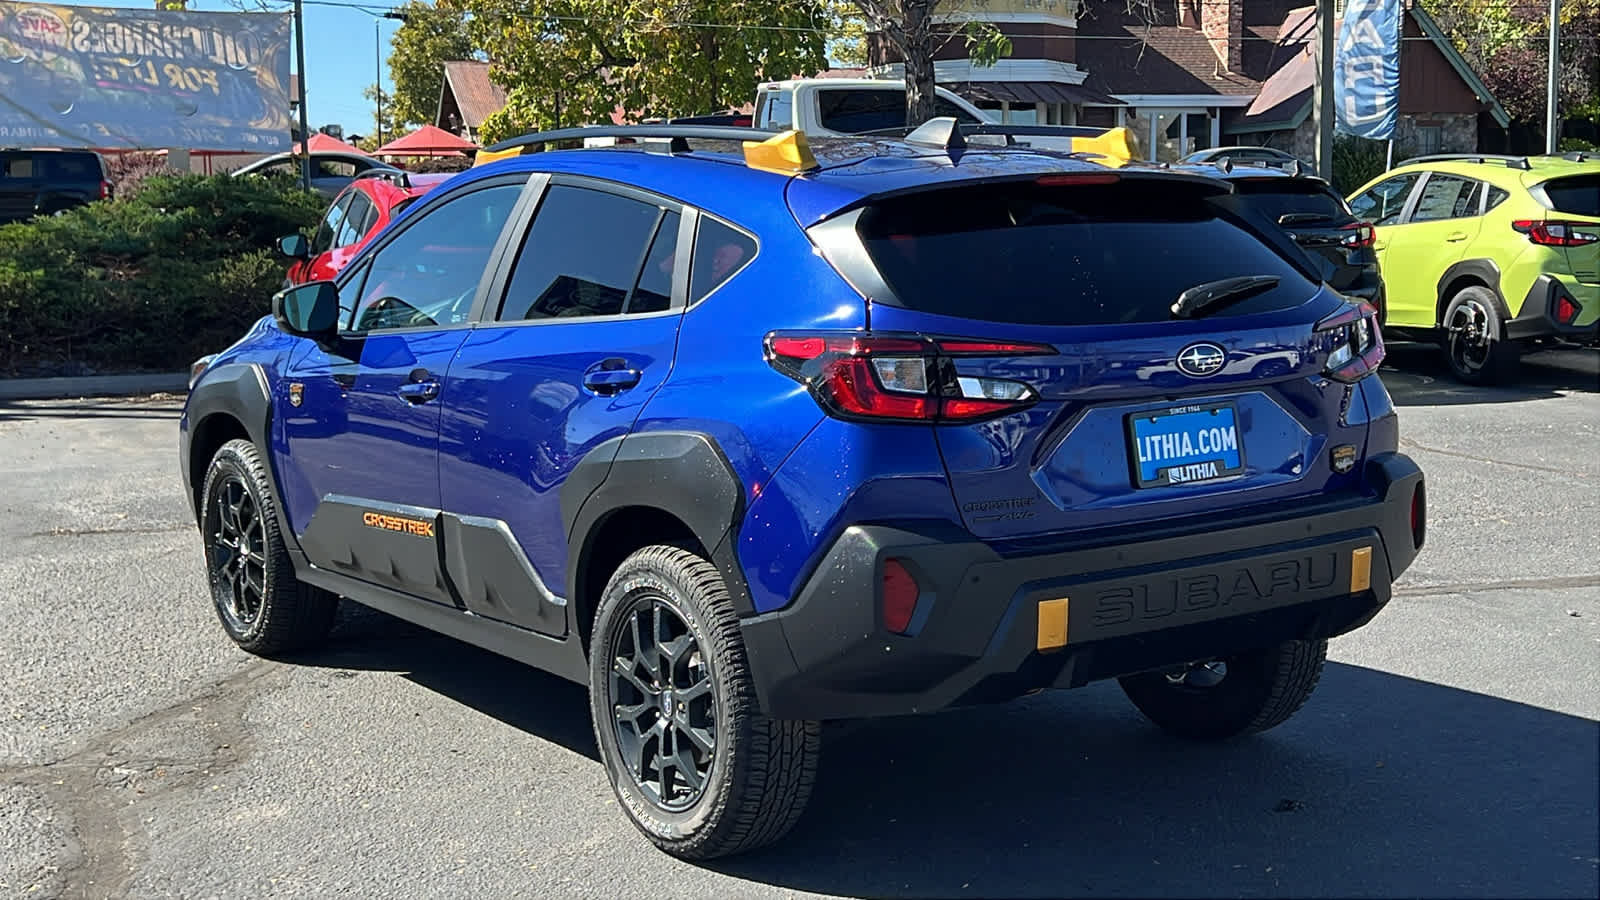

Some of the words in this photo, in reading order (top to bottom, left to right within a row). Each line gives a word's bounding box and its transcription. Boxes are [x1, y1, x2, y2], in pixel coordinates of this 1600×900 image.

[1169, 405, 1187, 415] SINCE
[1136, 426, 1237, 463] LITHIA.COM
[1180, 462, 1218, 480] LITHIA
[363, 512, 434, 537] CROSSTREK
[1094, 552, 1337, 627] SUBARU
